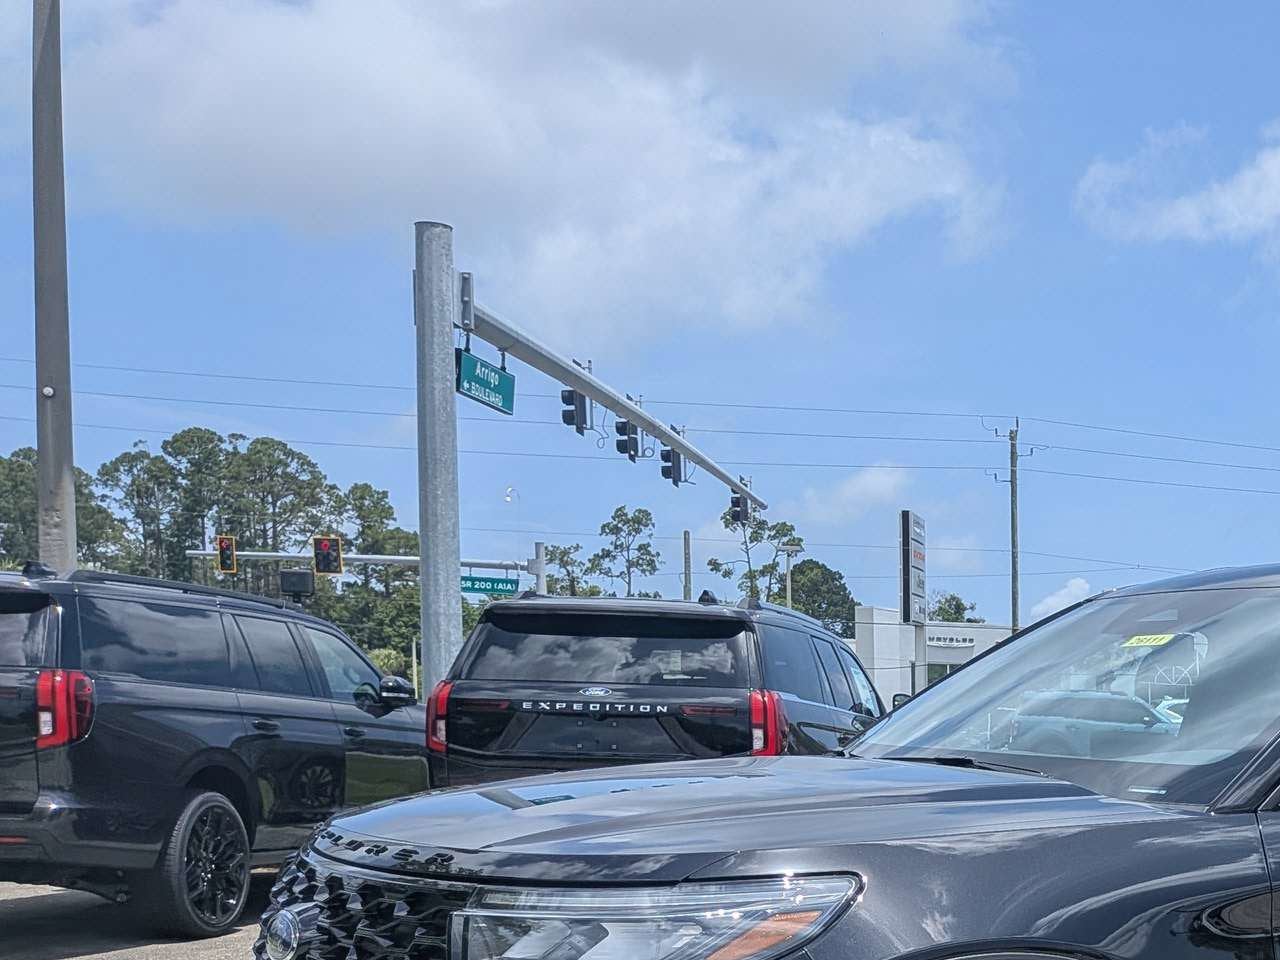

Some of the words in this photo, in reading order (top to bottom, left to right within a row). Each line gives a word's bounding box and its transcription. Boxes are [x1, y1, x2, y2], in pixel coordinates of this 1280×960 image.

[475, 361, 499, 387] Arrigo
[474, 581, 491, 589] 200
[494, 582, 515, 590] (A1A)
[522, 702, 668, 712] EXPEDITION
[320, 830, 455, 864] PLORER
